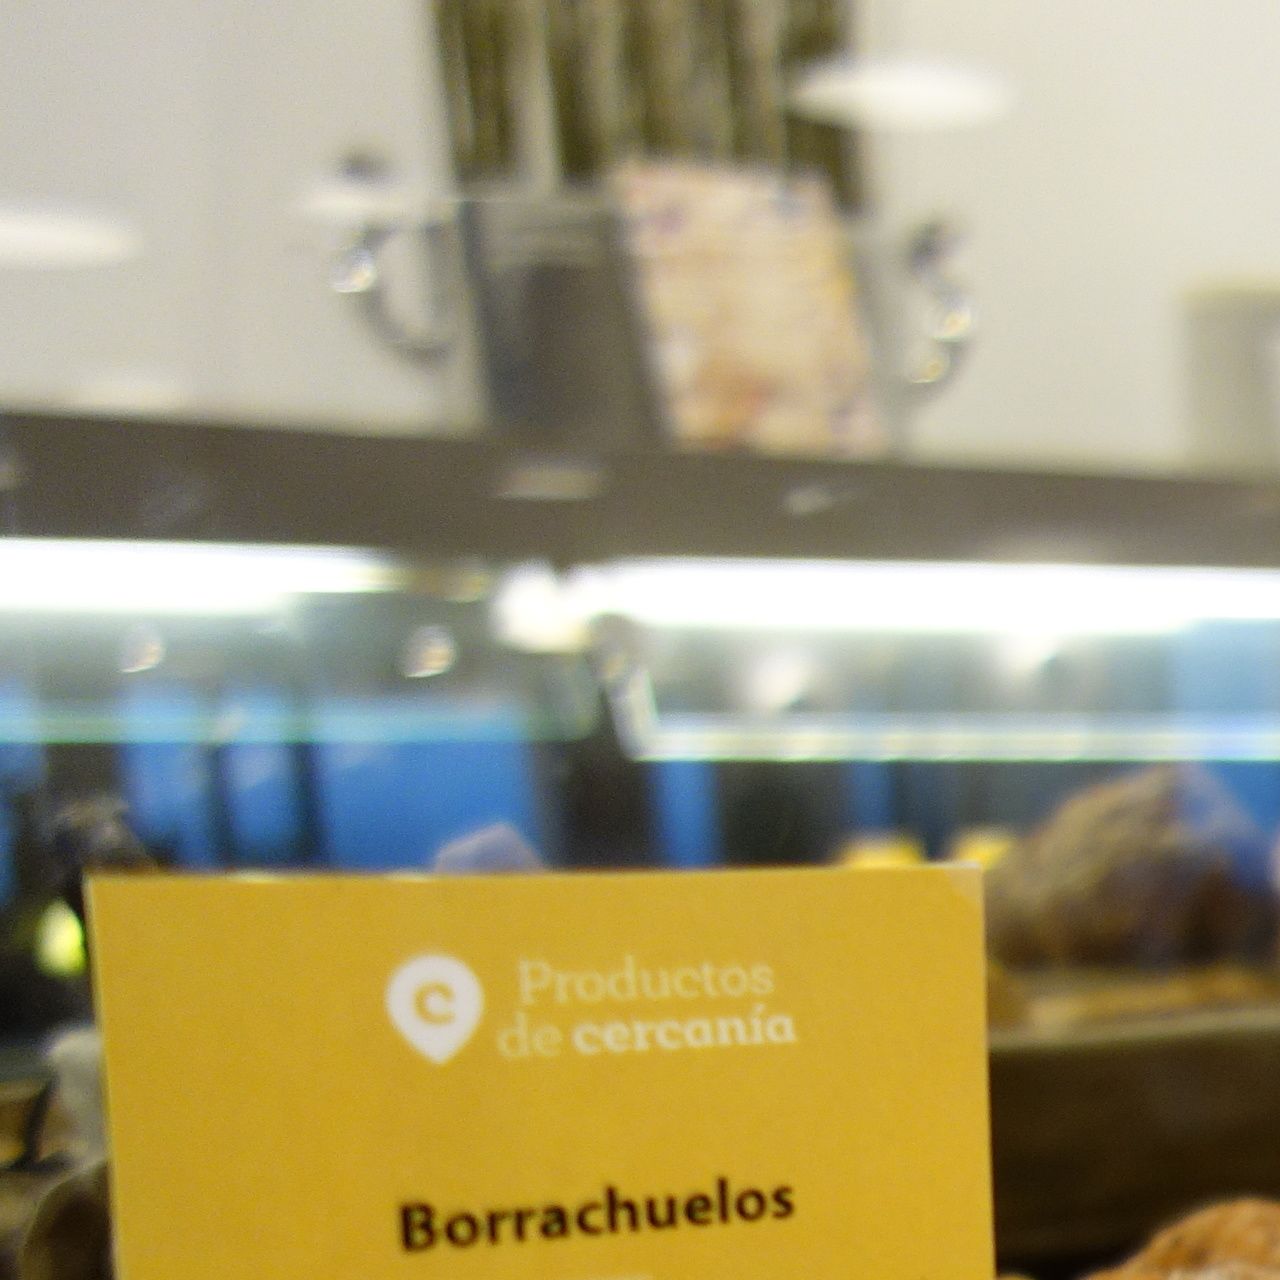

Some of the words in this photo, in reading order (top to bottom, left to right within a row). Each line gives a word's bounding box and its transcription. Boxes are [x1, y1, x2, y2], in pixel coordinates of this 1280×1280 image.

[517, 955, 775, 1005] Productos
[498, 1013, 563, 1059] de
[571, 1003, 797, 1056] cercanía
[399, 1176, 796, 1254] Borrachuelos
